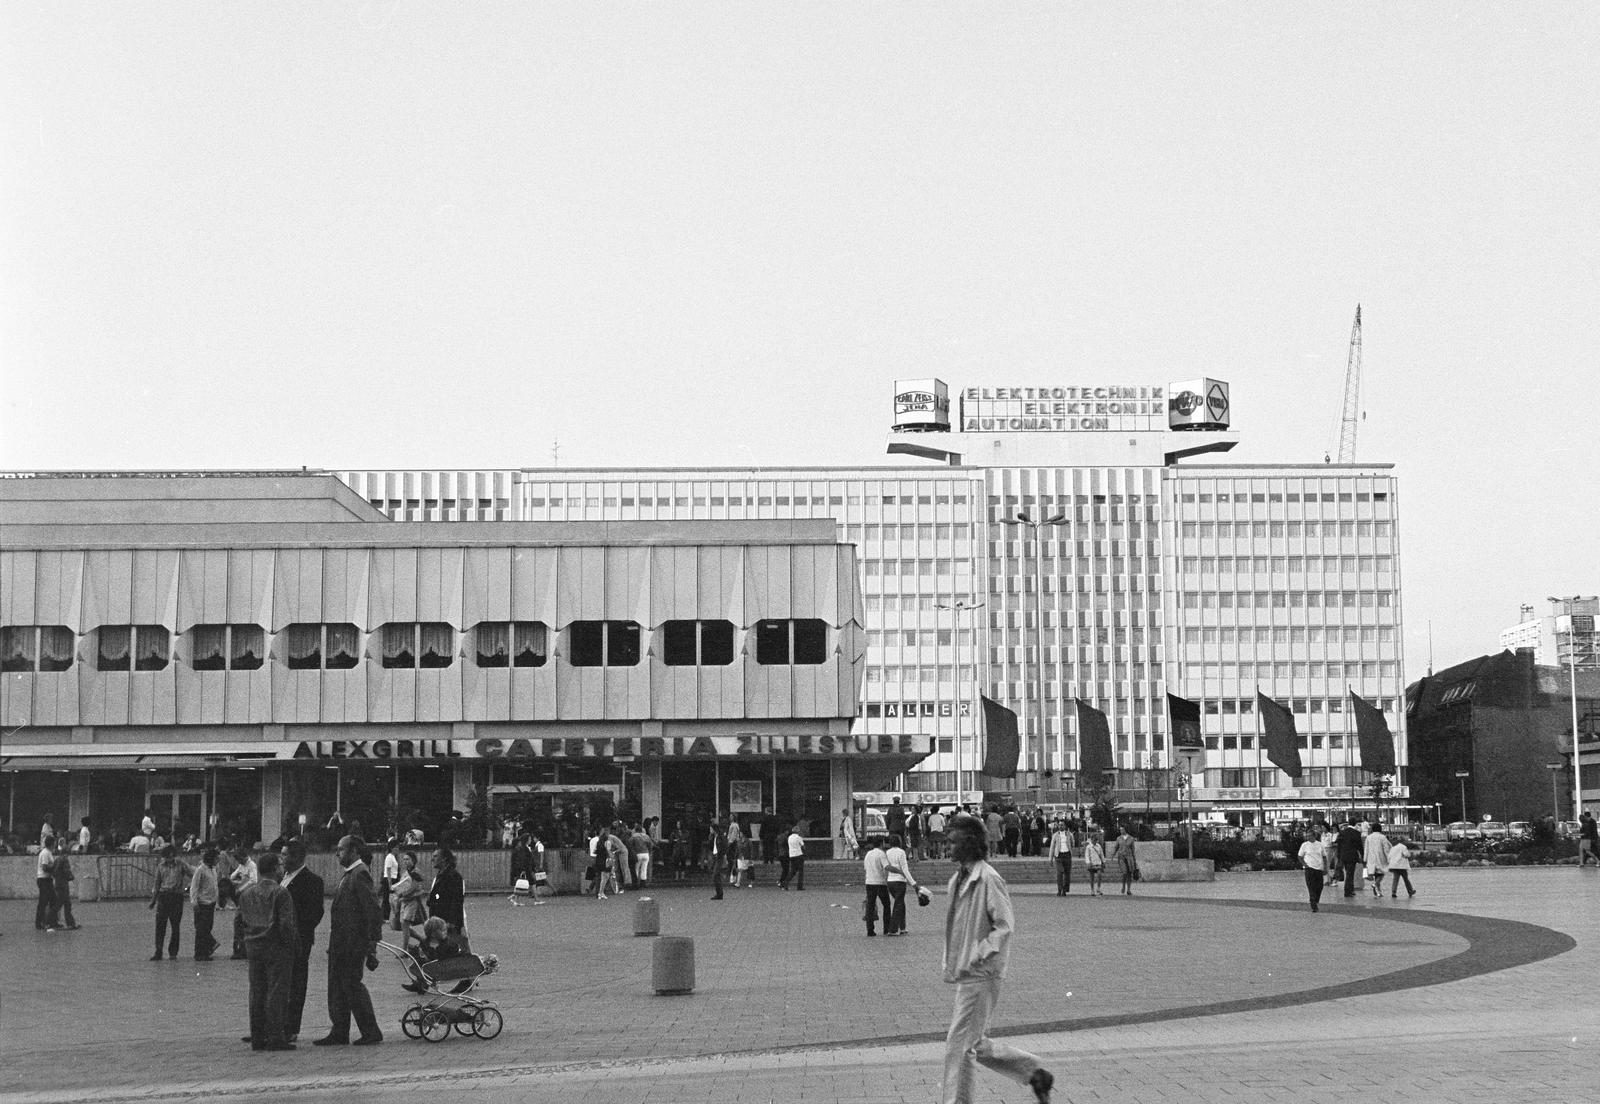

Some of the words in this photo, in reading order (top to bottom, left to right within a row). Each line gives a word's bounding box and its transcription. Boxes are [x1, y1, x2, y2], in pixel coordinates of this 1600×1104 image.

[966, 386, 1164, 400] ELEKTROTECHNIK
[1024, 402, 1164, 415] ELEKTRONIK
[966, 417, 1109, 430] AUTOMATION
[887, 703, 970, 716] ALLER
[292, 739, 461, 759] ALEXGRILL
[475, 736, 718, 758] CAFETERIA
[737, 735, 914, 754] ZILLESTUBE
